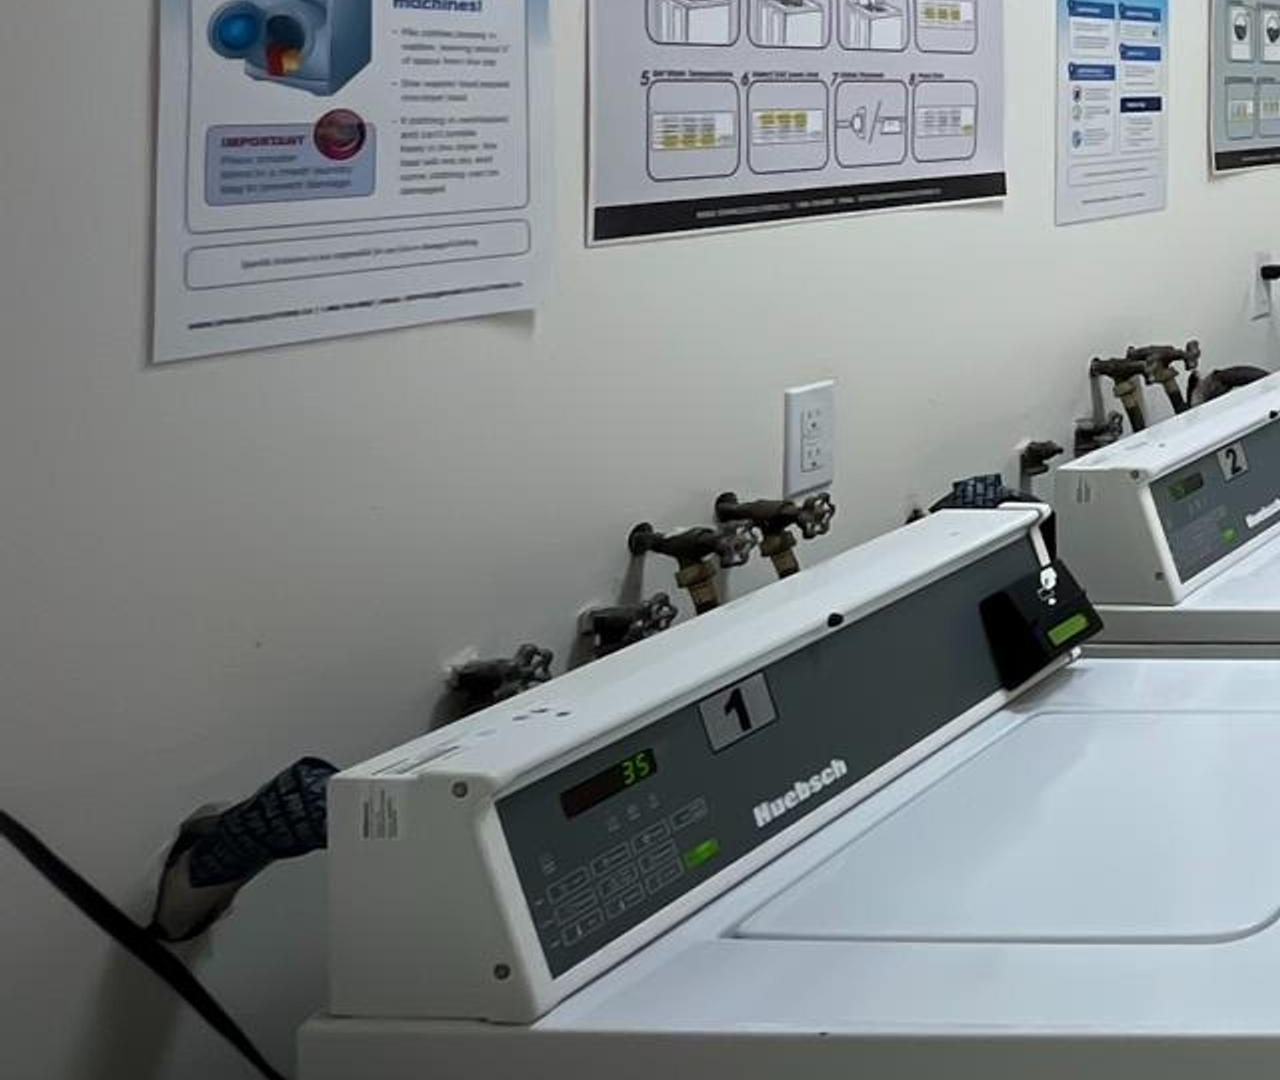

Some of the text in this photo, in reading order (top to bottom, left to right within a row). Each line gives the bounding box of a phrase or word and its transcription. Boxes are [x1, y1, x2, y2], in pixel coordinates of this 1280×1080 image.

[640, 70, 650, 86] 5
[1225, 448, 1242, 475] 2
[724, 688, 752, 732] 1
[621, 752, 651, 785] 35
[752, 758, 848, 828] Huebsch
